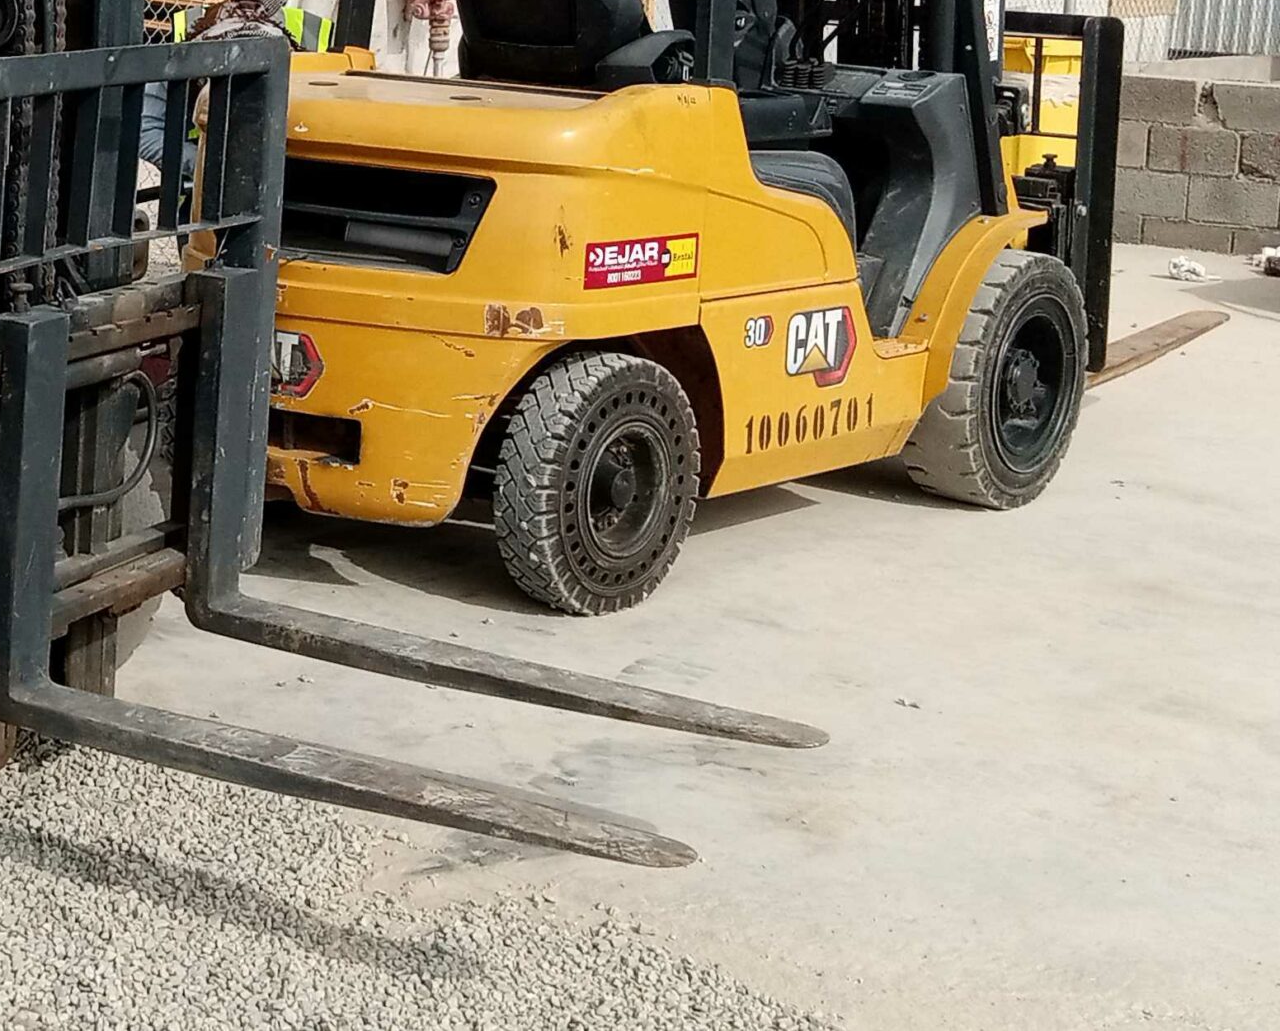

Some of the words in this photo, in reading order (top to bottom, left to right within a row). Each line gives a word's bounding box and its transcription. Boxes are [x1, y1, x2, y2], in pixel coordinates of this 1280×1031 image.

[745, 318, 766, 347] 30
[787, 309, 843, 375] CAT
[745, 393, 874, 455] 10060701
